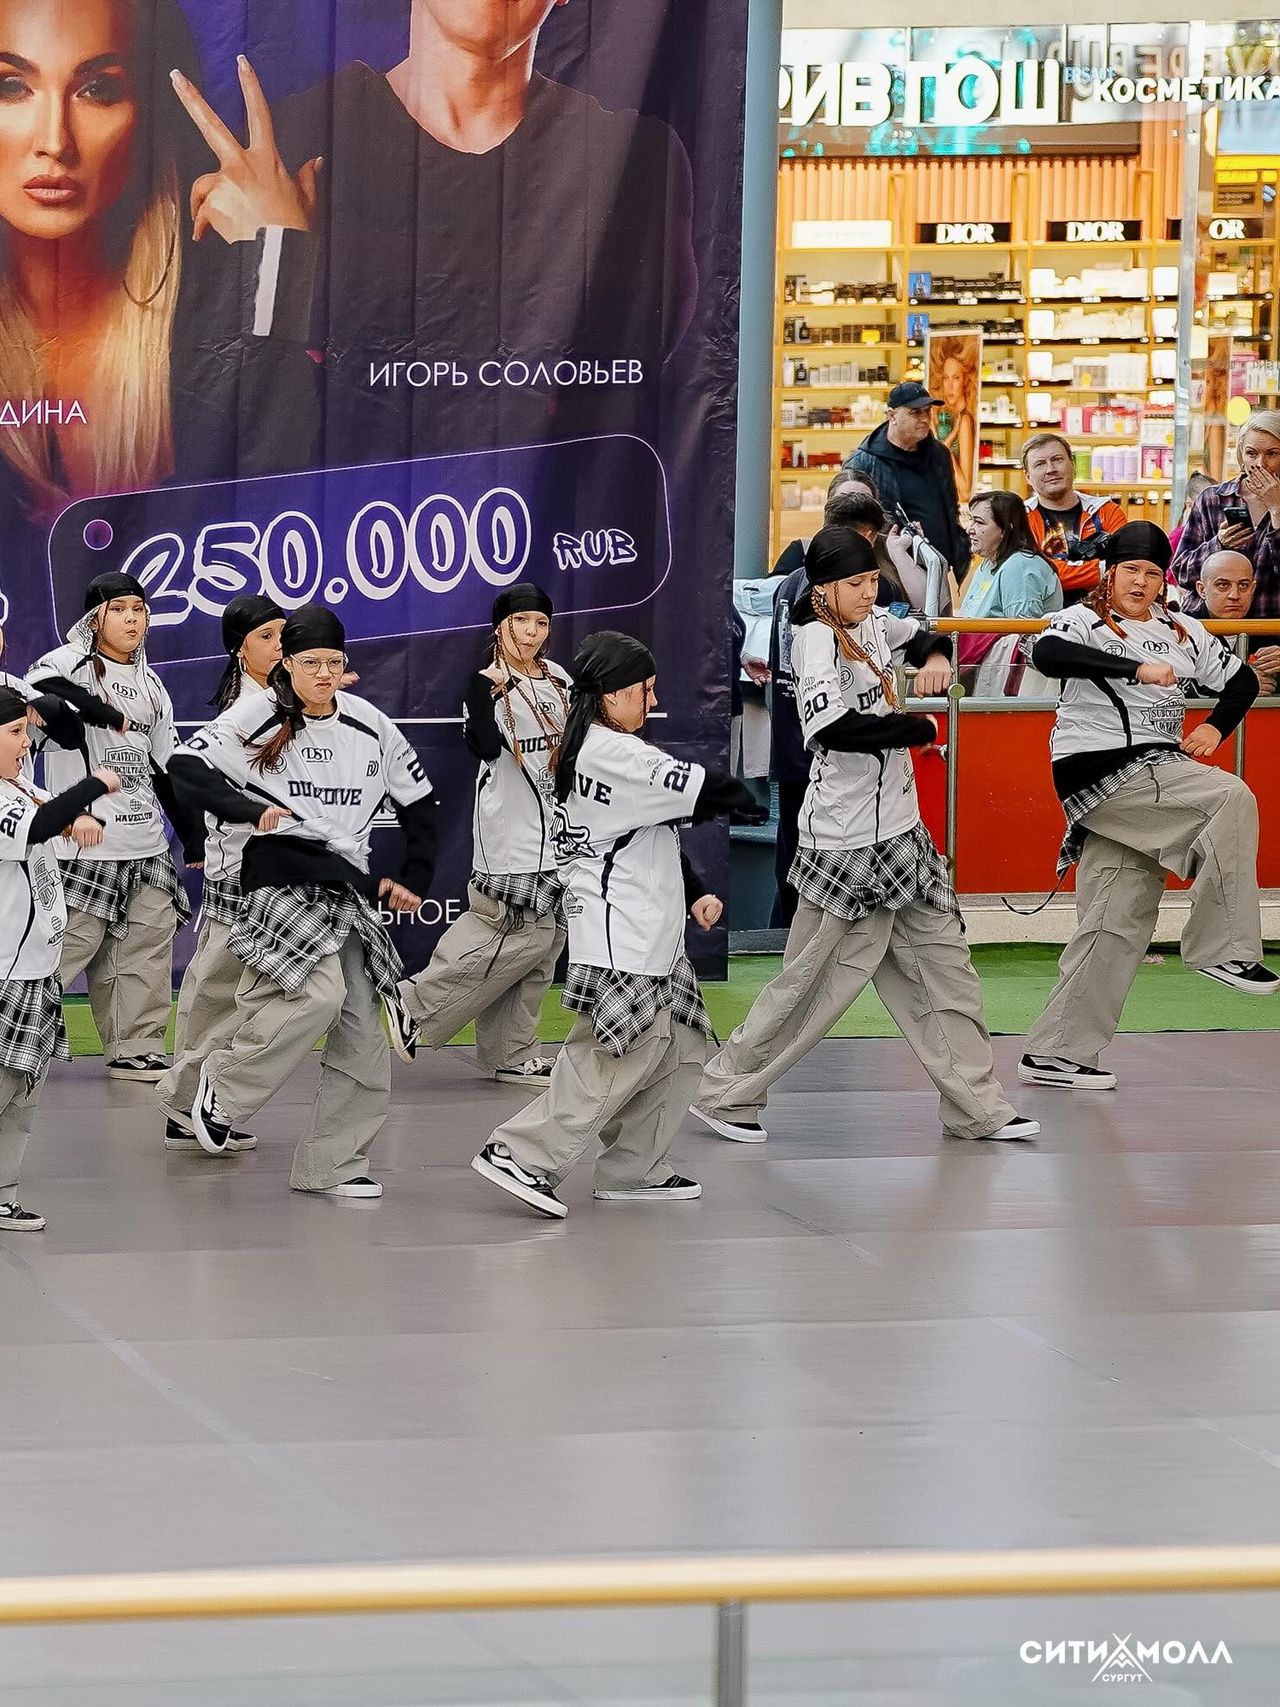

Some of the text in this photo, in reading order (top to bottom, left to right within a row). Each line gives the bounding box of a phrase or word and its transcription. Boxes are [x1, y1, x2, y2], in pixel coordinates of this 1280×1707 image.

[904, 56, 1059, 126] ГОШ
[1093, 76, 1280, 104] КОСМЕТИКА
[936, 222, 996, 244] DIOR
[1066, 221, 1125, 242] DIOR
[1208, 219, 1246, 240] OR
[370, 359, 644, 387] ИГОРЬ СОЛОВЬЕВ
[120, 487, 637, 626] 250.000 RUB
[804, 691, 828, 723] 20
